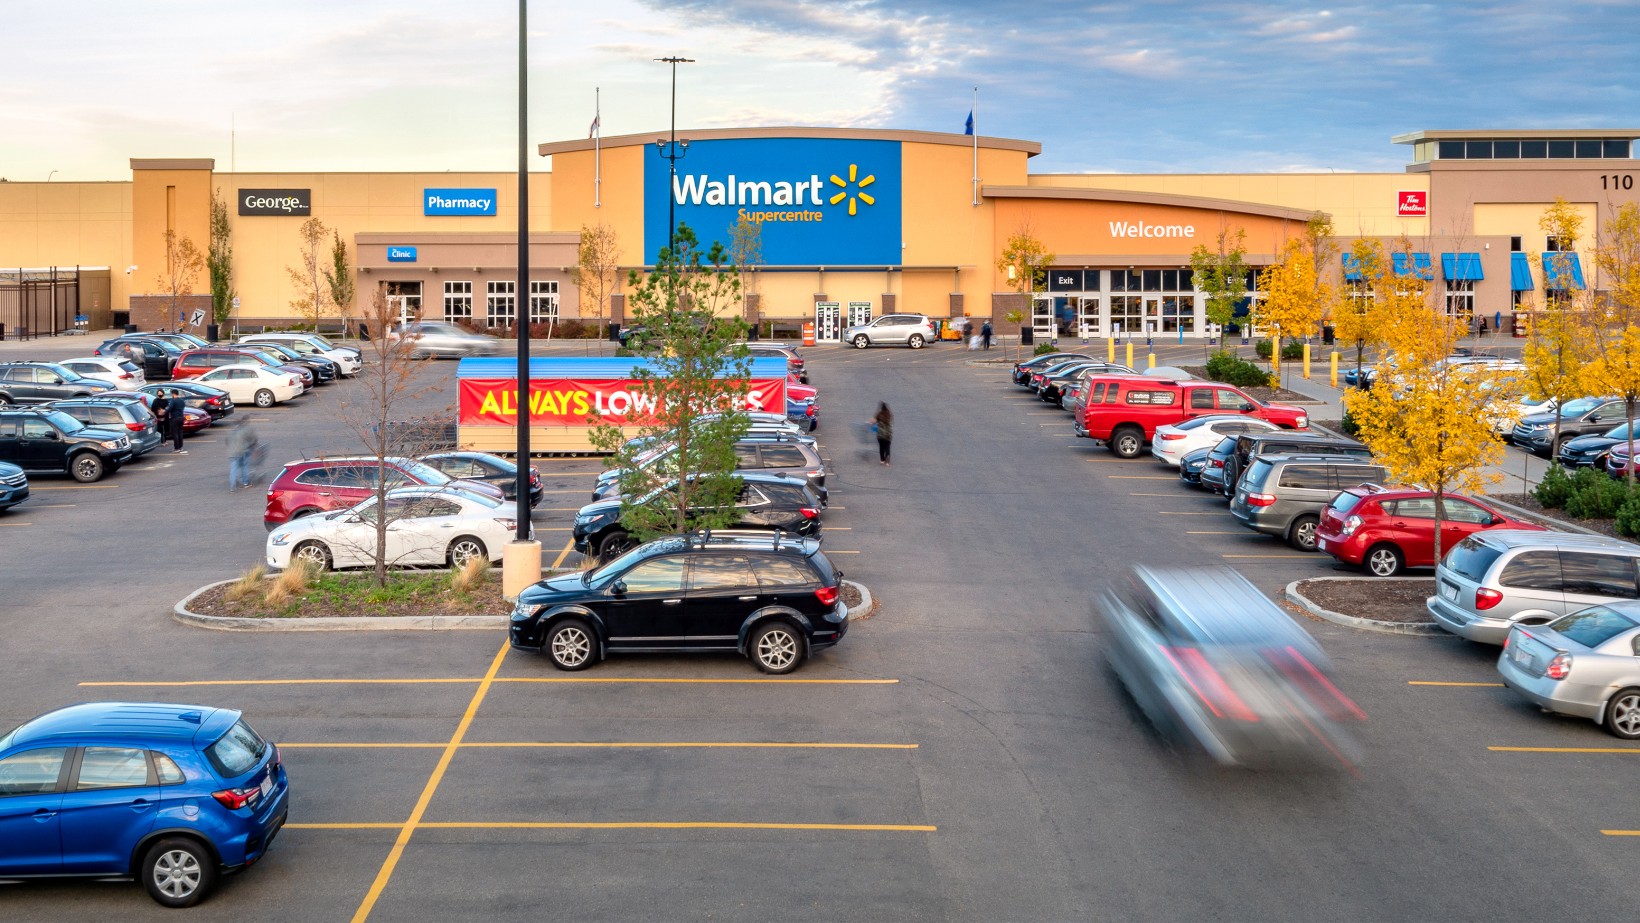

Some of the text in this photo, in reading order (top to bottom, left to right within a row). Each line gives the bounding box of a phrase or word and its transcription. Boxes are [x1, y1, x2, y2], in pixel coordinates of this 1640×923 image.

[672, 174, 823, 205] Walmart
[1600, 175, 1634, 190] 110
[428, 196, 491, 211] Pharmacy
[1406, 194, 1420, 204] Tim
[737, 208, 823, 224] Supercentre
[1108, 220, 1195, 238] Welcome
[391, 250, 411, 258] Clinic
[1058, 276, 1073, 284] Exit
[479, 390, 590, 415] ALWAYS
[595, 390, 658, 416] LOW
